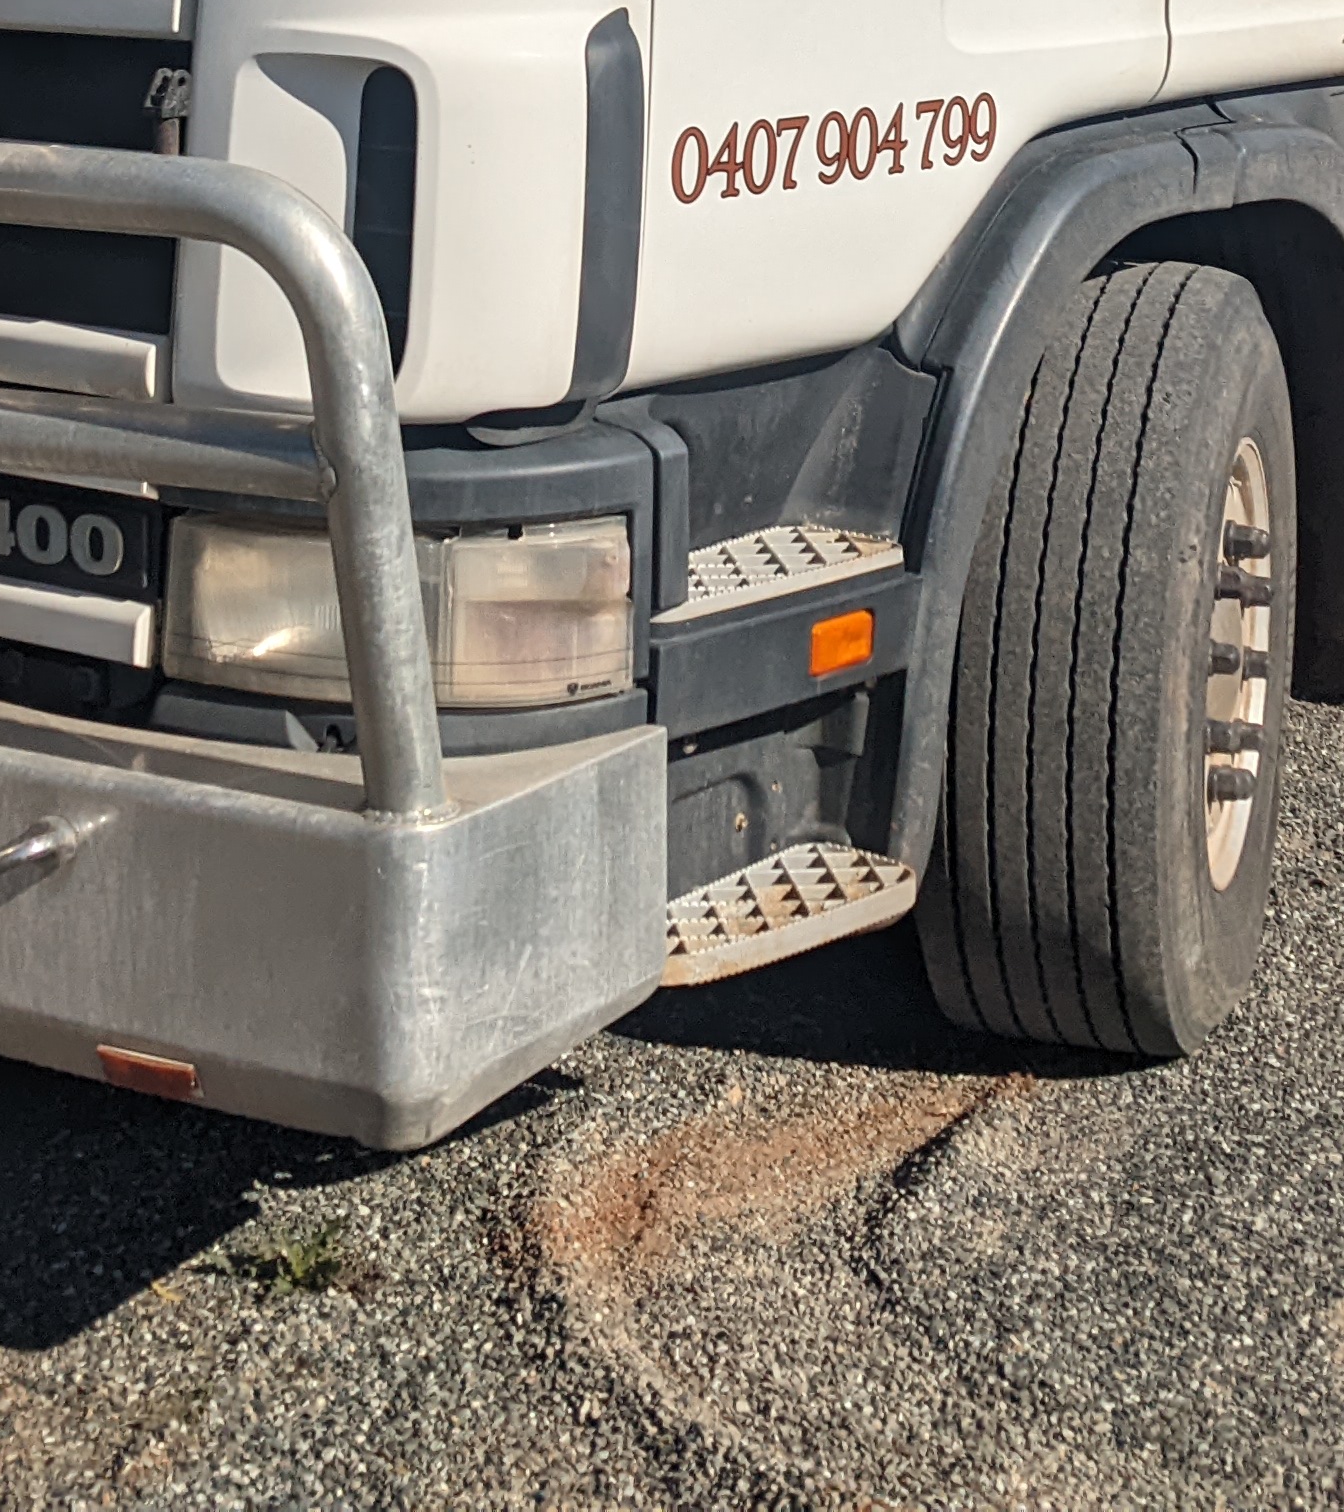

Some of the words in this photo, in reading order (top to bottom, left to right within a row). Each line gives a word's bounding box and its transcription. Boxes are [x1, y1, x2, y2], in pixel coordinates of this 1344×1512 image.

[671, 115, 810, 204] 0407
[816, 102, 908, 185] 904
[915, 92, 997, 170] 799
